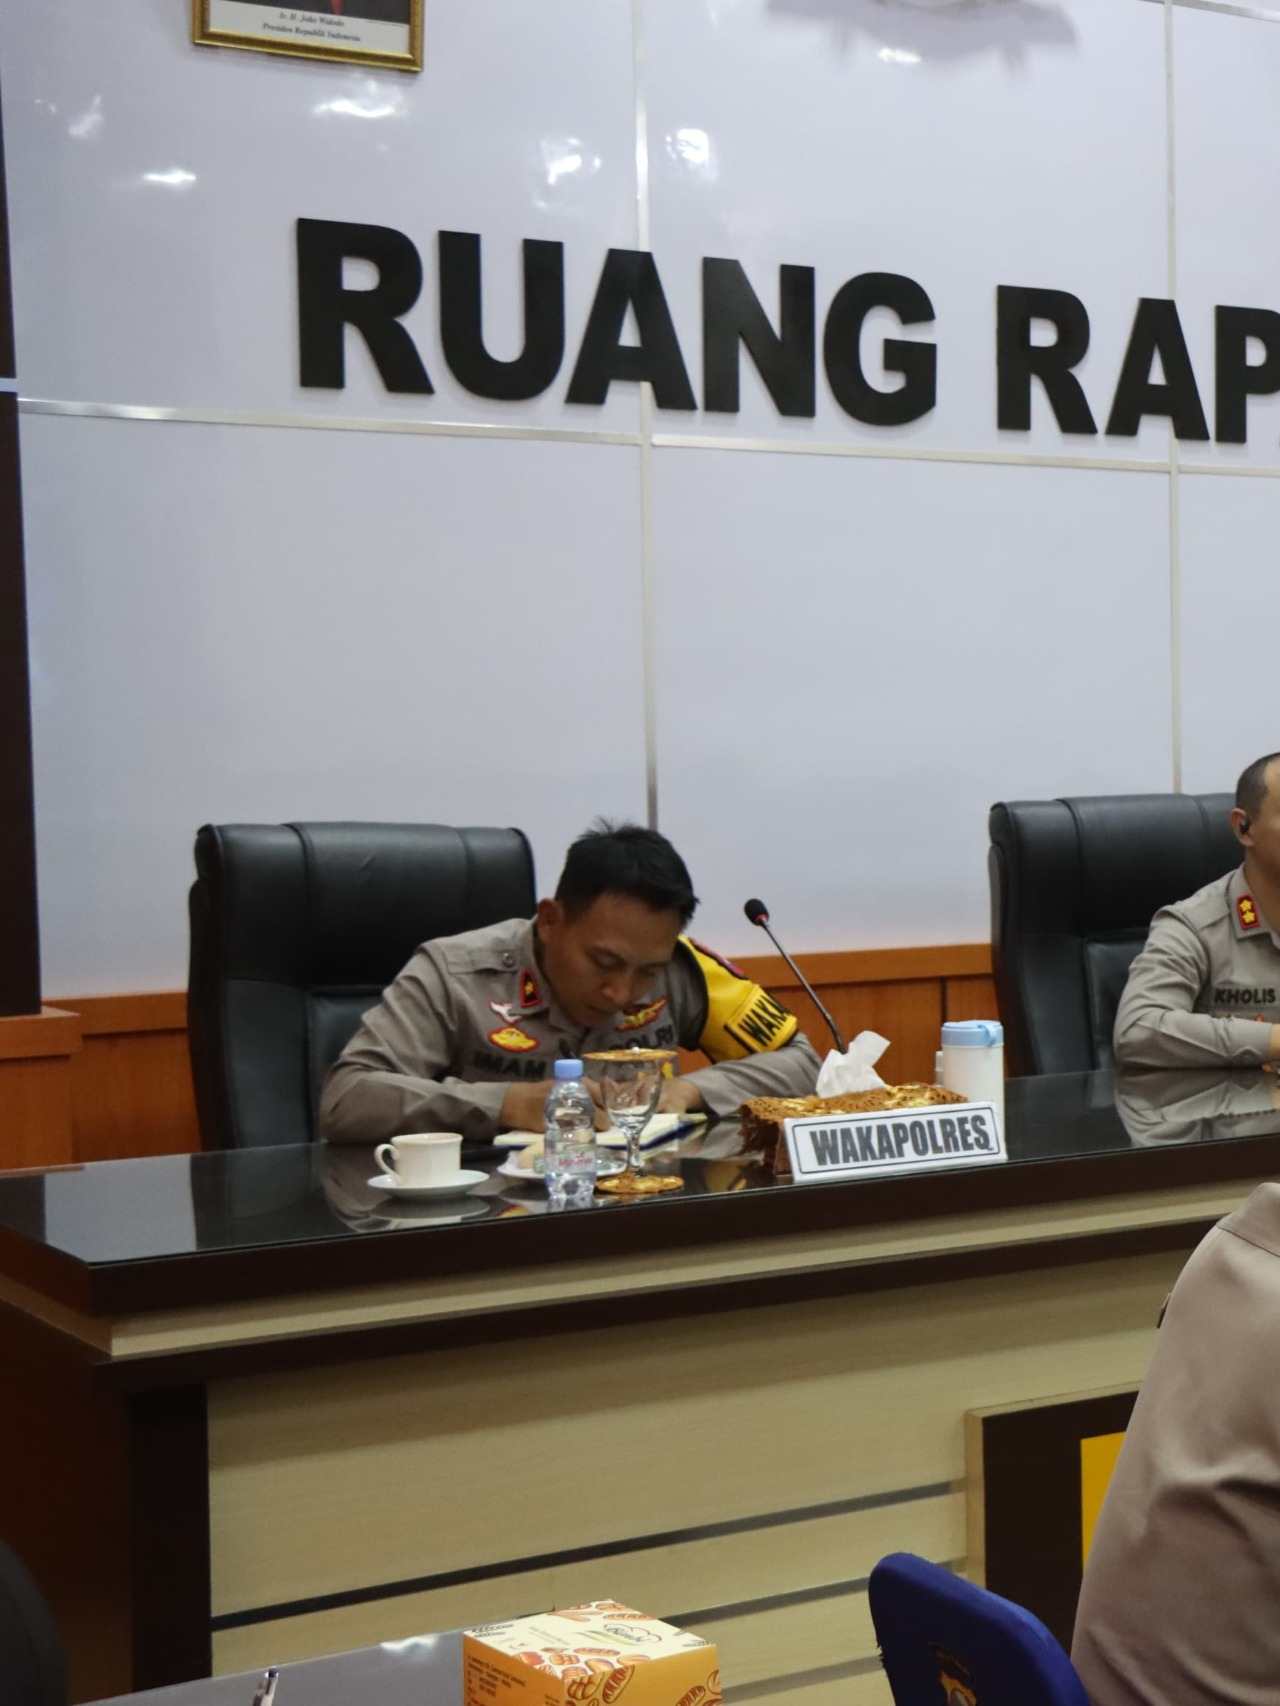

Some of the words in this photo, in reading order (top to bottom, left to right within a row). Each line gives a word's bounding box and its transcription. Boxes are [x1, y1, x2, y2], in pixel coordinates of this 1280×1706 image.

[297, 216, 938, 427] RUANG
[1213, 988, 1277, 1005] KHOLIS
[809, 1114, 991, 1166] WAKAPOLRES
